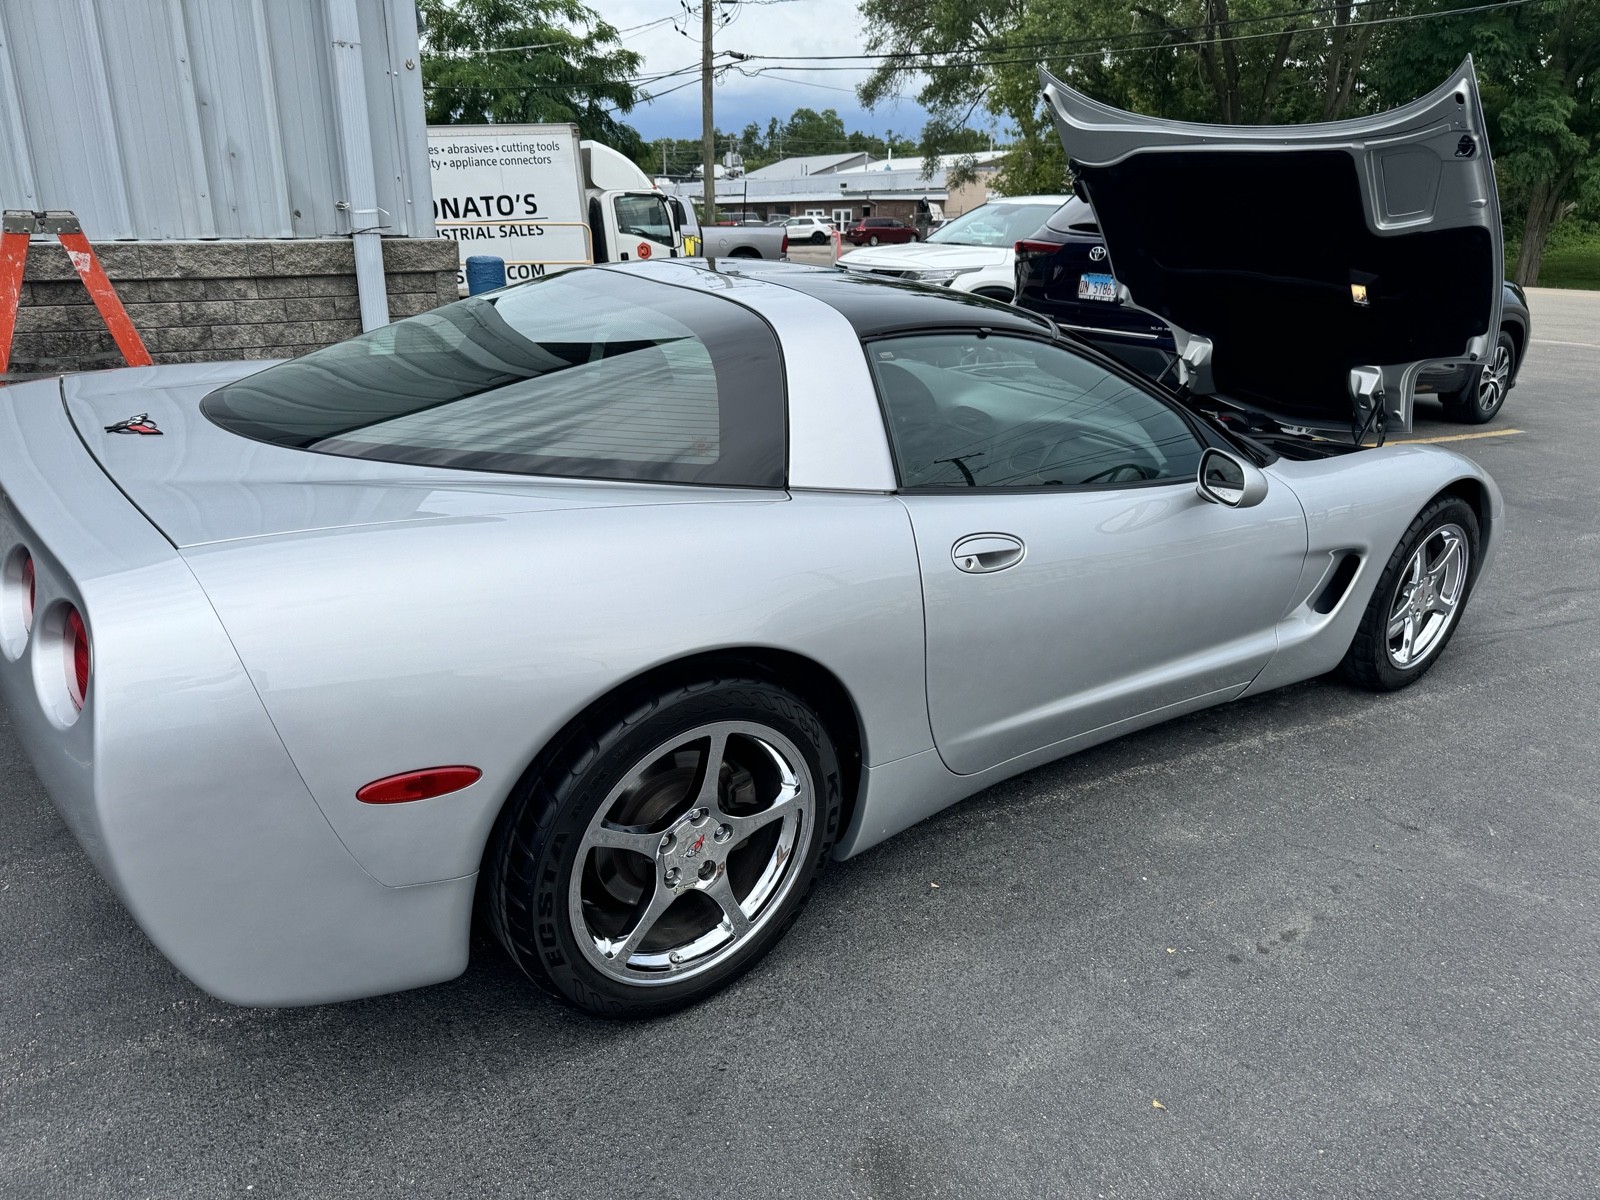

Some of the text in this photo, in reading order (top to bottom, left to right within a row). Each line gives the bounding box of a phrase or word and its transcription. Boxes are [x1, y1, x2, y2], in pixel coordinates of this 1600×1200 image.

[447, 143, 494, 155] abrasives
[501, 141, 536, 154] cutting
[536, 140, 560, 152] tools
[430, 155, 552, 170] ty appliance connectors
[499, 225, 544, 238] SALES
[506, 263, 546, 280] COM
[538, 831, 570, 968] ECSTA
